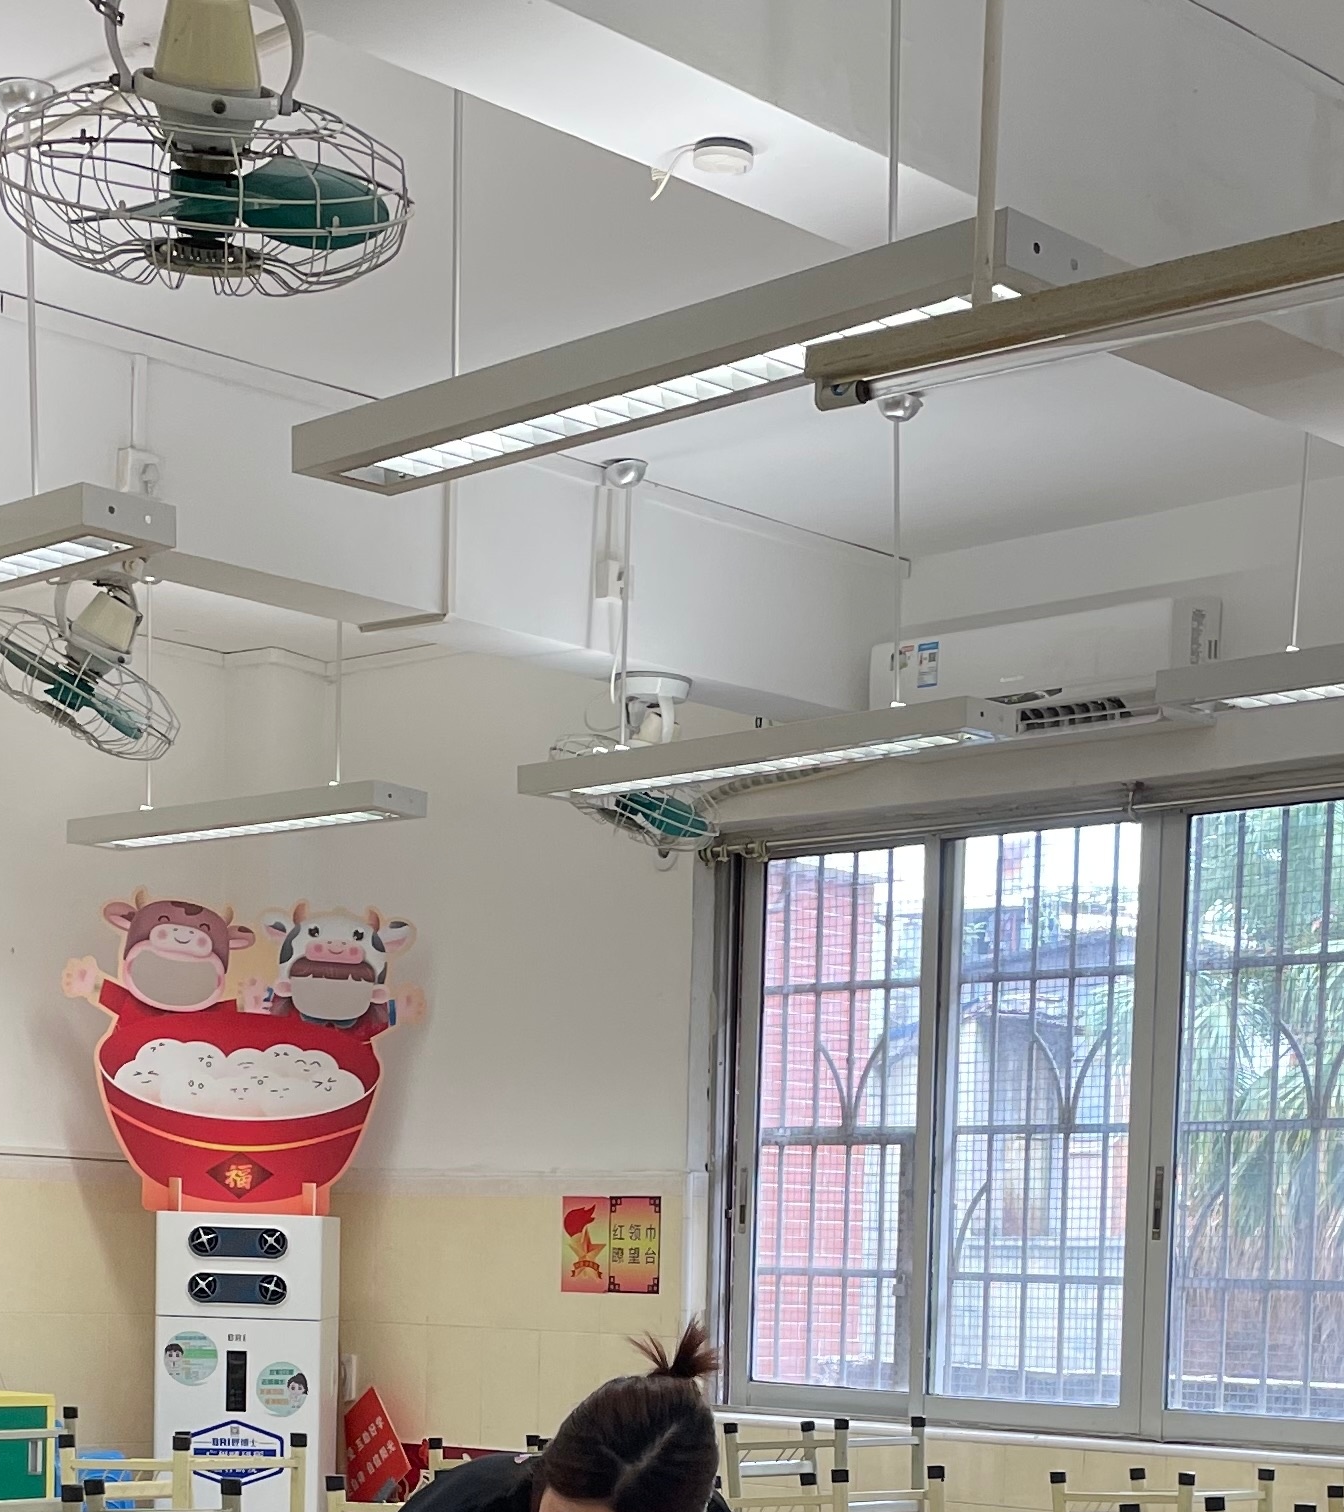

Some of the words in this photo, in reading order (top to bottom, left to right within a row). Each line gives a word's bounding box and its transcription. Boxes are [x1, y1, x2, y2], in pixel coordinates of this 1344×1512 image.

[225, 1164, 253, 1190] 福
[612, 1223, 657, 1242] 红领巾
[228, 1333, 247, 1342] BRI
